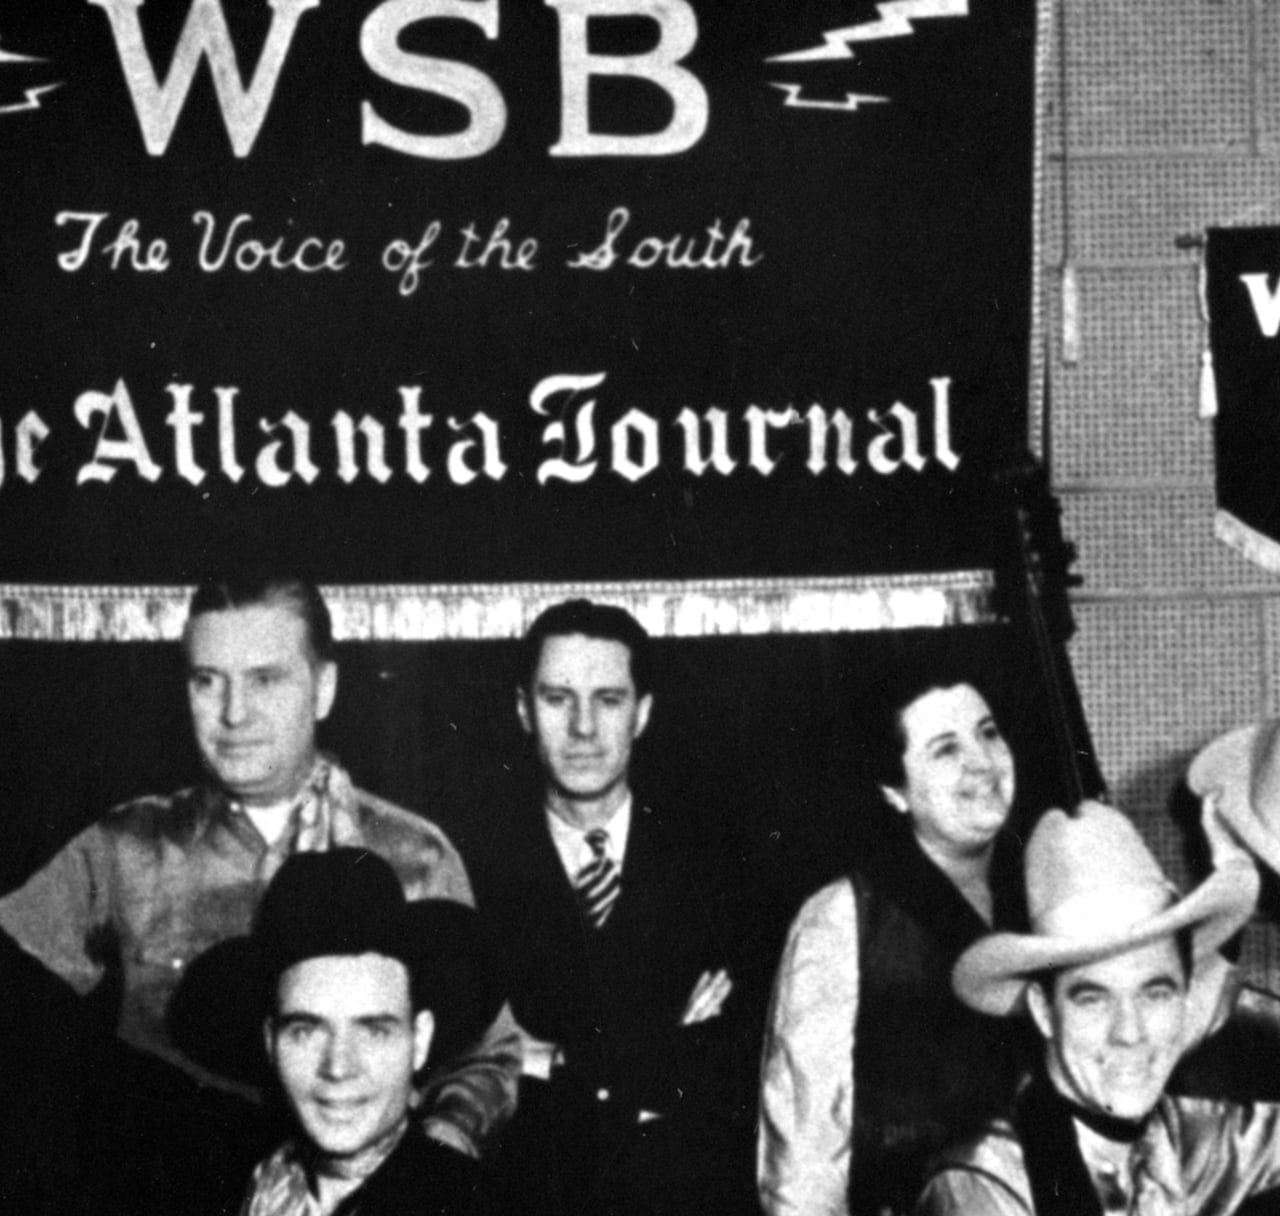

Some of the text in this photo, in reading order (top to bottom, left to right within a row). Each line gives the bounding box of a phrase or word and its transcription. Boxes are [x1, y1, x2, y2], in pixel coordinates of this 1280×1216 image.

[86, 0, 709, 160] WSB
[53, 205, 764, 298] The Voice of the South
[72, 377, 509, 489] Atlanta
[528, 371, 963, 486] Journal
